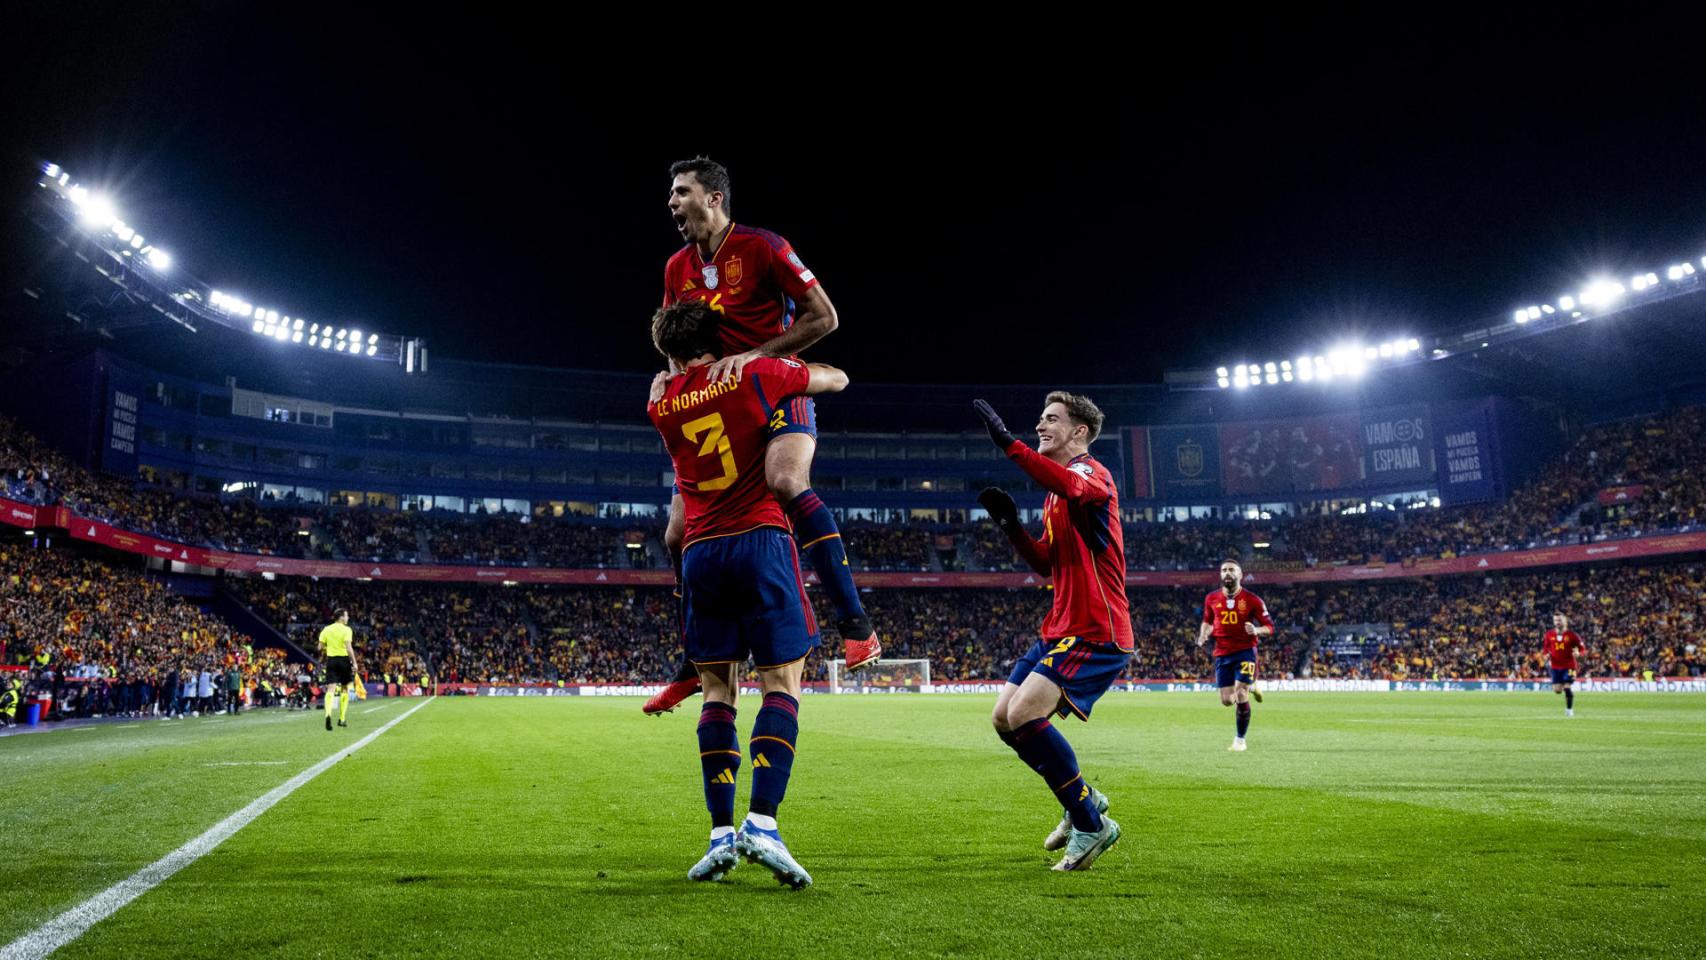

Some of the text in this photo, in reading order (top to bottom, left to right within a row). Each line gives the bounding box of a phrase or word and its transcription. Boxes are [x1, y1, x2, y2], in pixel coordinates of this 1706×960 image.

[657, 374, 738, 416] LE NORMAND
[1445, 431, 1477, 448] VAMOS
[681, 412, 738, 491] 3
[1373, 443, 1420, 472] ESPAÑA
[1448, 455, 1480, 472] VAMOS
[1221, 611, 1238, 624] 20
[1555, 642, 1565, 650] 14
[1240, 661, 1255, 675] 20
[934, 684, 998, 694] FASHION
[1267, 680, 1329, 691] FASHION
[1580, 681, 1650, 692] FASHION
